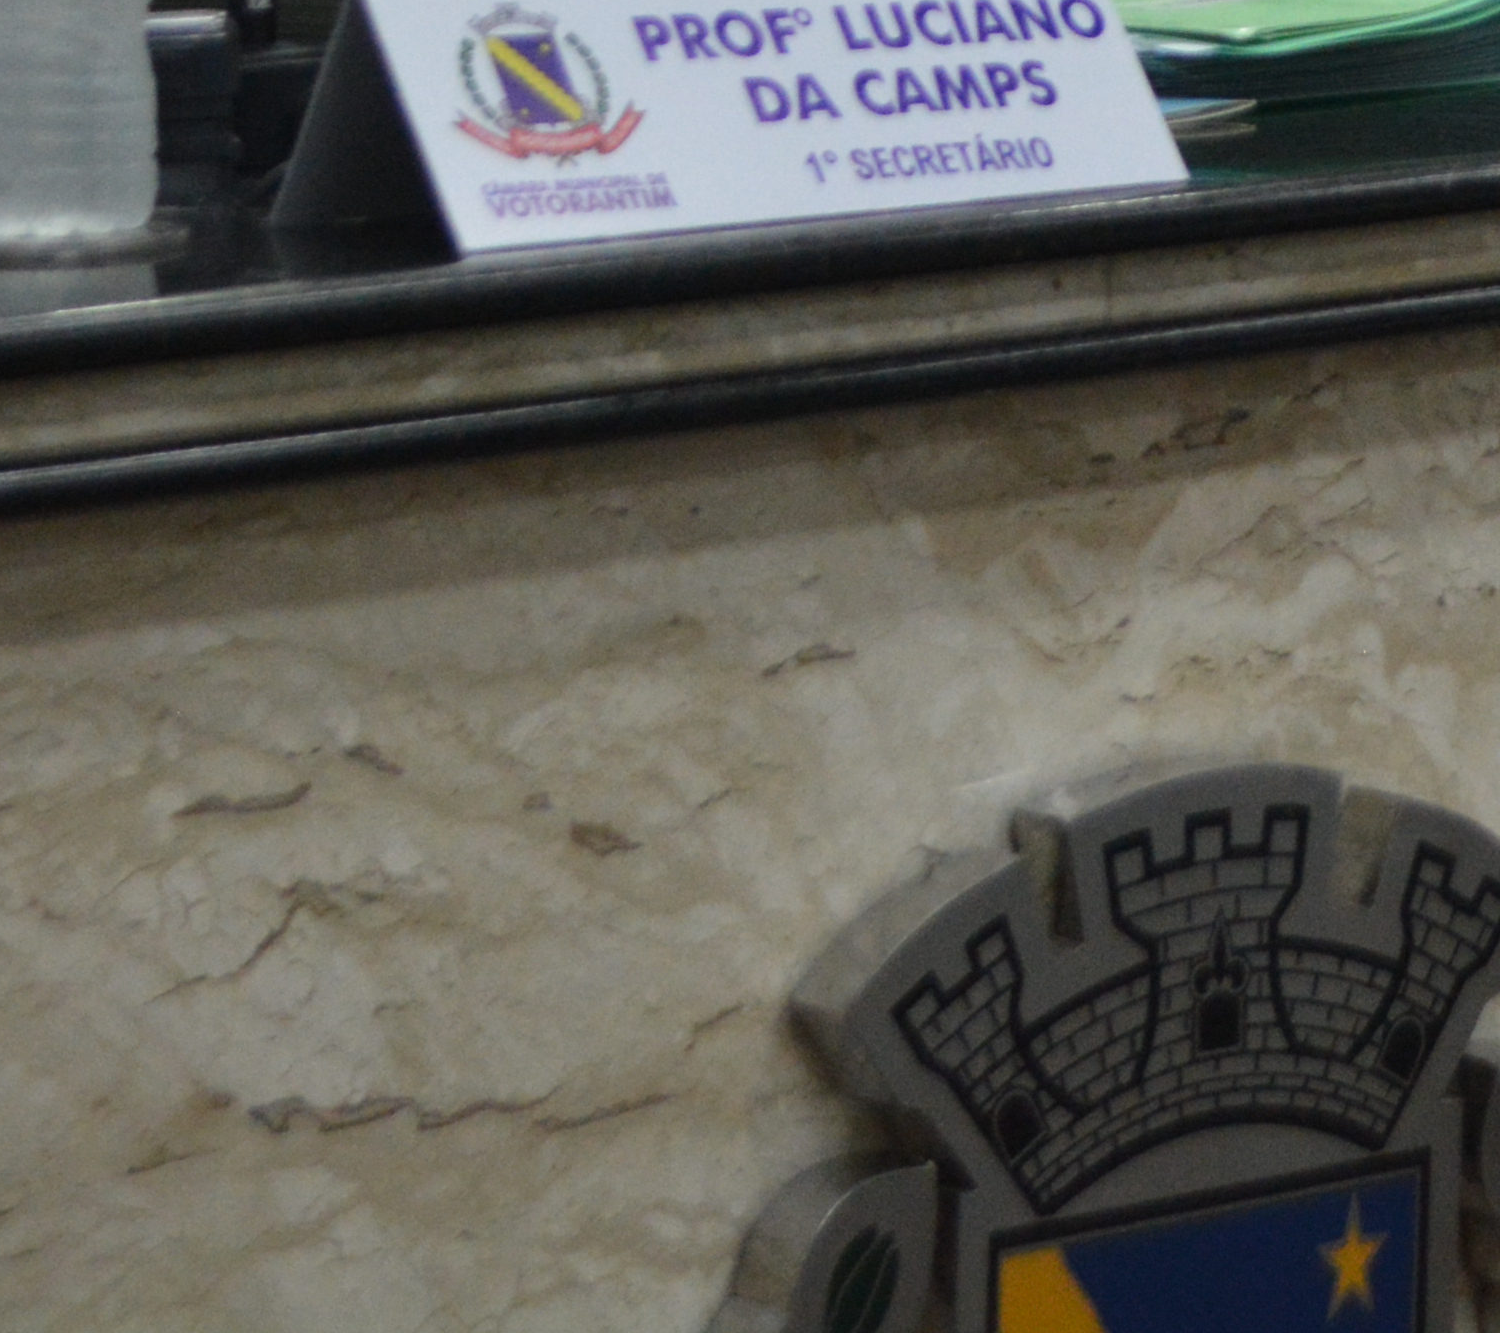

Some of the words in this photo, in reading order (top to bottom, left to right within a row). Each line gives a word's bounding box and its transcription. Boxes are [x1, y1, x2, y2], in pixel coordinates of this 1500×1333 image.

[741, 72, 843, 125] DA
[854, 59, 1060, 117] CAMPS
[849, 131, 1055, 183] SECRETÁRIO
[485, 185, 679, 219] VOTORANTIM
